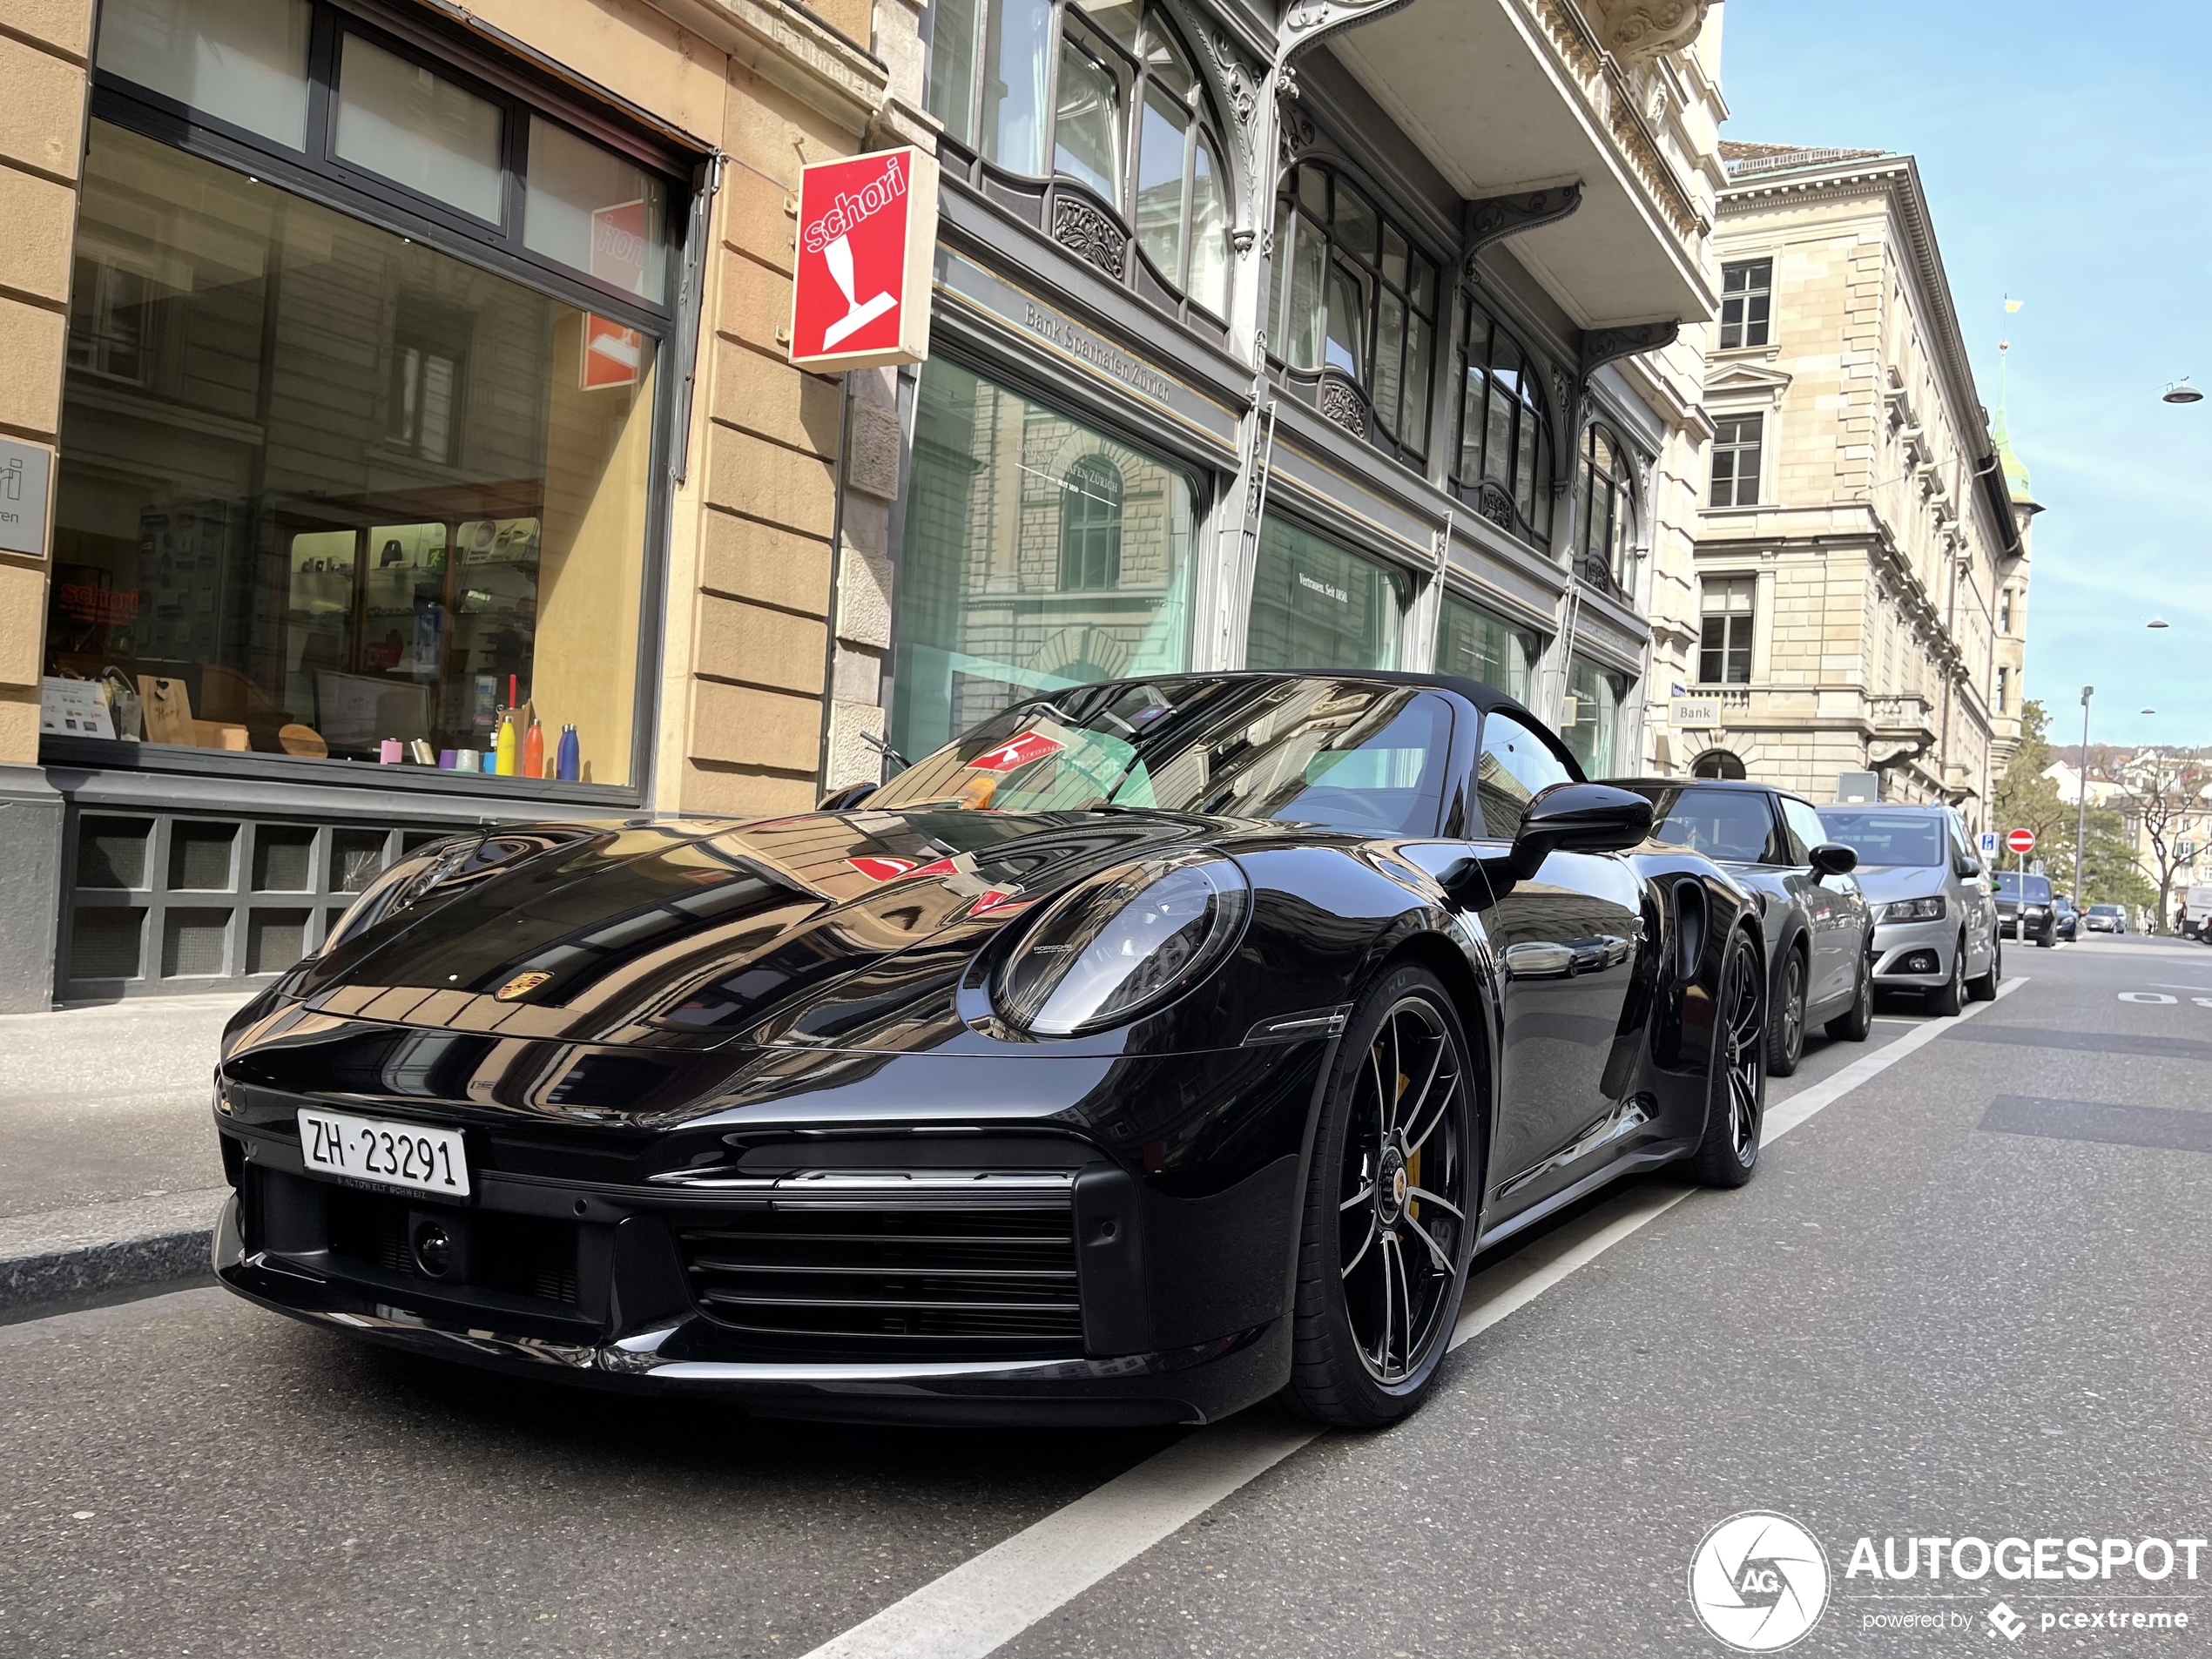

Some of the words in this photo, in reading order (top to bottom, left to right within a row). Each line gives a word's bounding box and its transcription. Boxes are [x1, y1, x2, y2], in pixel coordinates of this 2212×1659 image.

[804, 156, 906, 253] schori
[1024, 301, 1062, 344] Bank
[1063, 324, 1130, 381] Sparhafen
[1130, 362, 1170, 404] Zürich
[1089, 469, 1118, 493] ZÜRICH
[1325, 583, 1335, 598] Seit
[1680, 706, 1710, 718] Bank
[389, 1185, 427, 1199] SCHWEIZ
